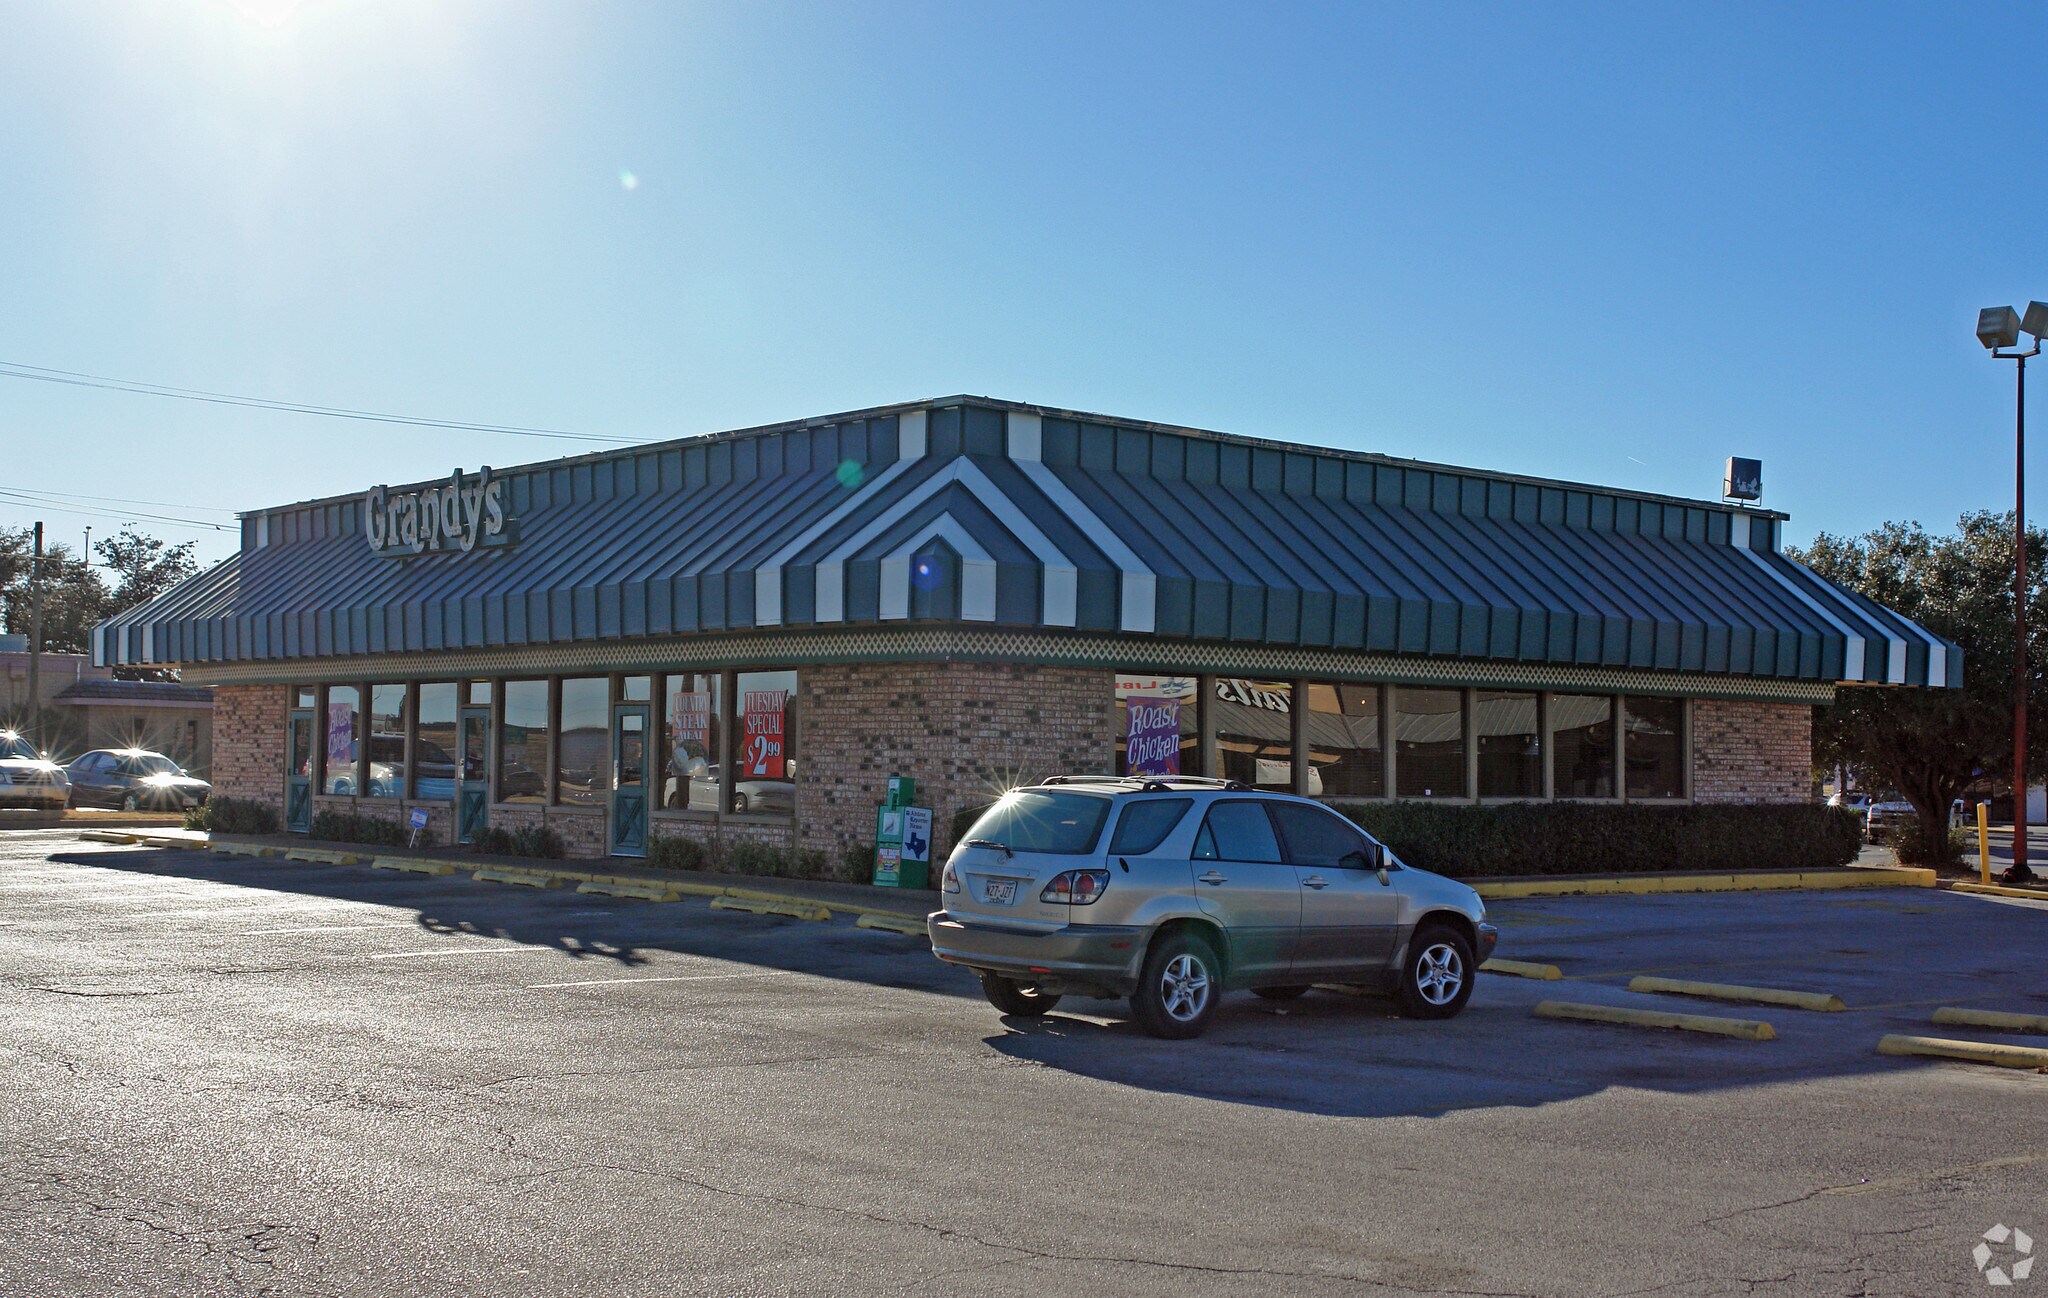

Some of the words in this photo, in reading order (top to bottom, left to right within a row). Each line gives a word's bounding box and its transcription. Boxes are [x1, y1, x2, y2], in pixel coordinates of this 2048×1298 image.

[366, 465, 504, 553] Grandy's
[675, 696, 707, 712] COUNTRY
[745, 692, 786, 712] TUESDAY
[675, 714, 708, 729] STEAK
[747, 714, 782, 735] SPECIAL
[1128, 703, 1179, 737] Roast
[680, 730, 704, 740] MEAL
[1128, 734, 1179, 765] Chicken
